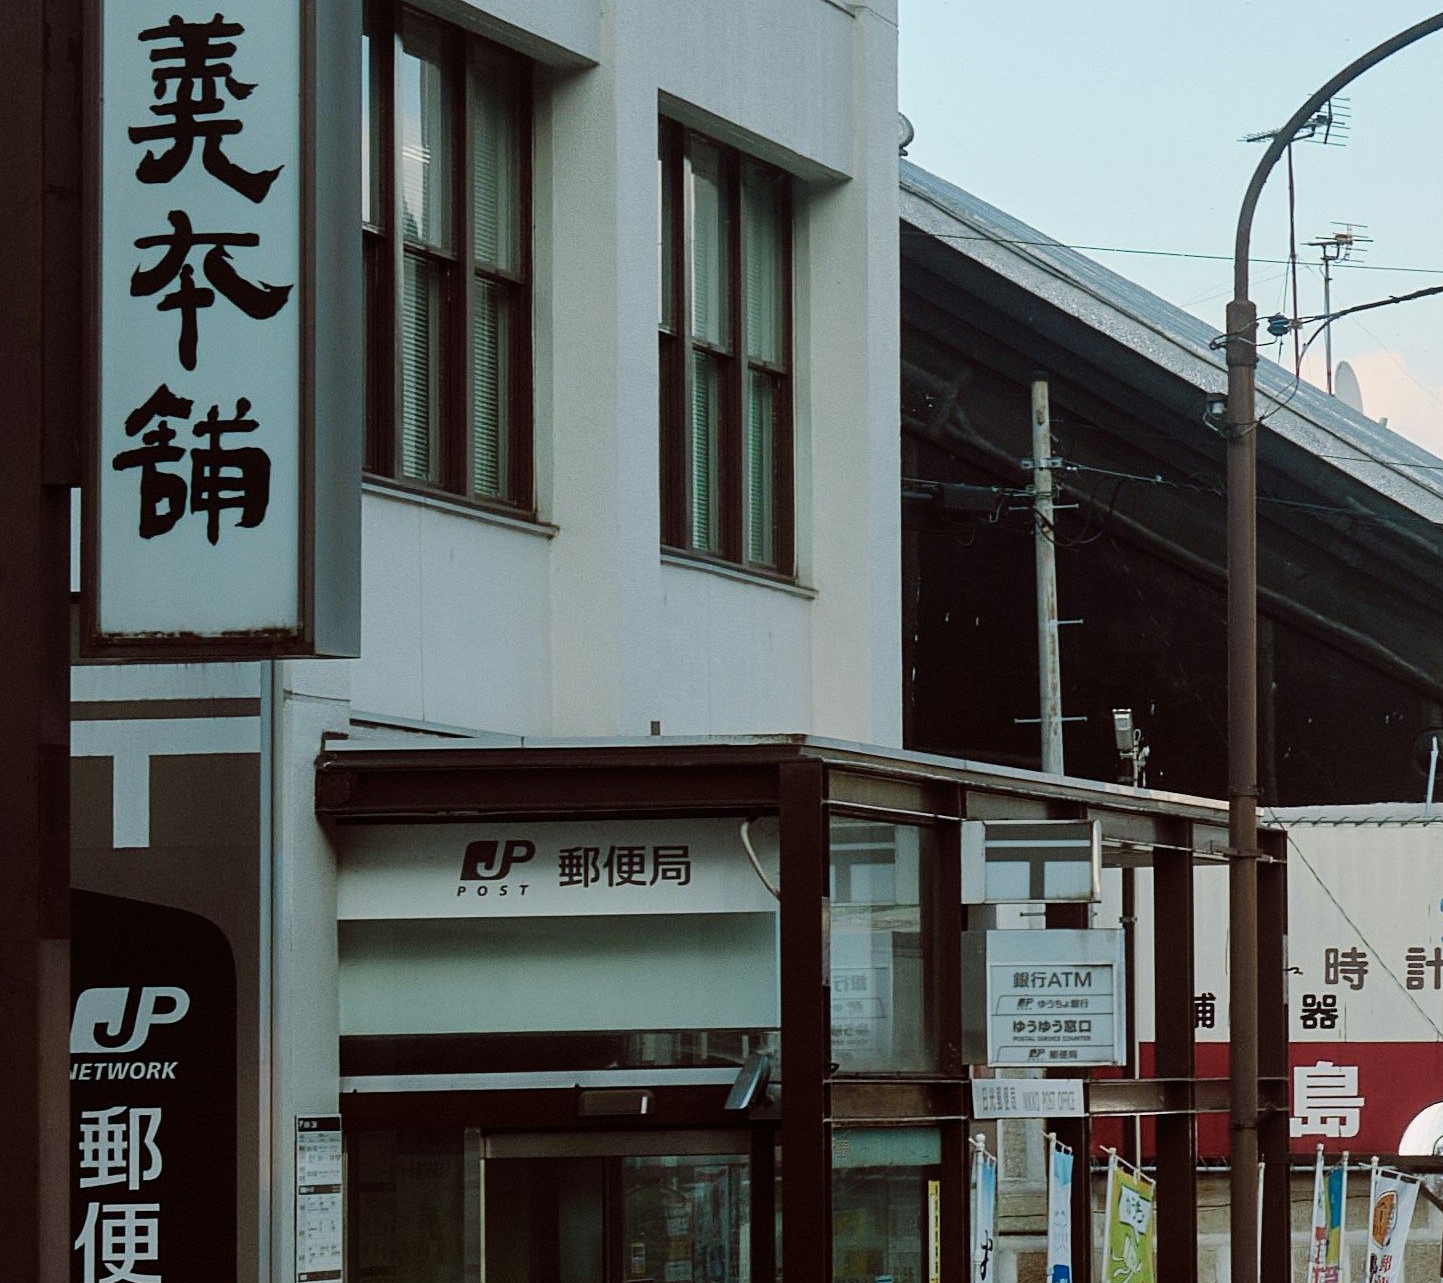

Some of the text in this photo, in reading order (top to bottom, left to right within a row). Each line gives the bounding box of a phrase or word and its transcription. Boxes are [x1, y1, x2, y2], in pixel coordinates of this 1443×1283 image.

[557, 843, 694, 889] 郵便局
[456, 883, 530, 898] POST
[1012, 971, 1092, 989] 銀行ATM
[70, 987, 191, 1053] JP
[1012, 1020, 1092, 1033] ゆうゆう窓口
